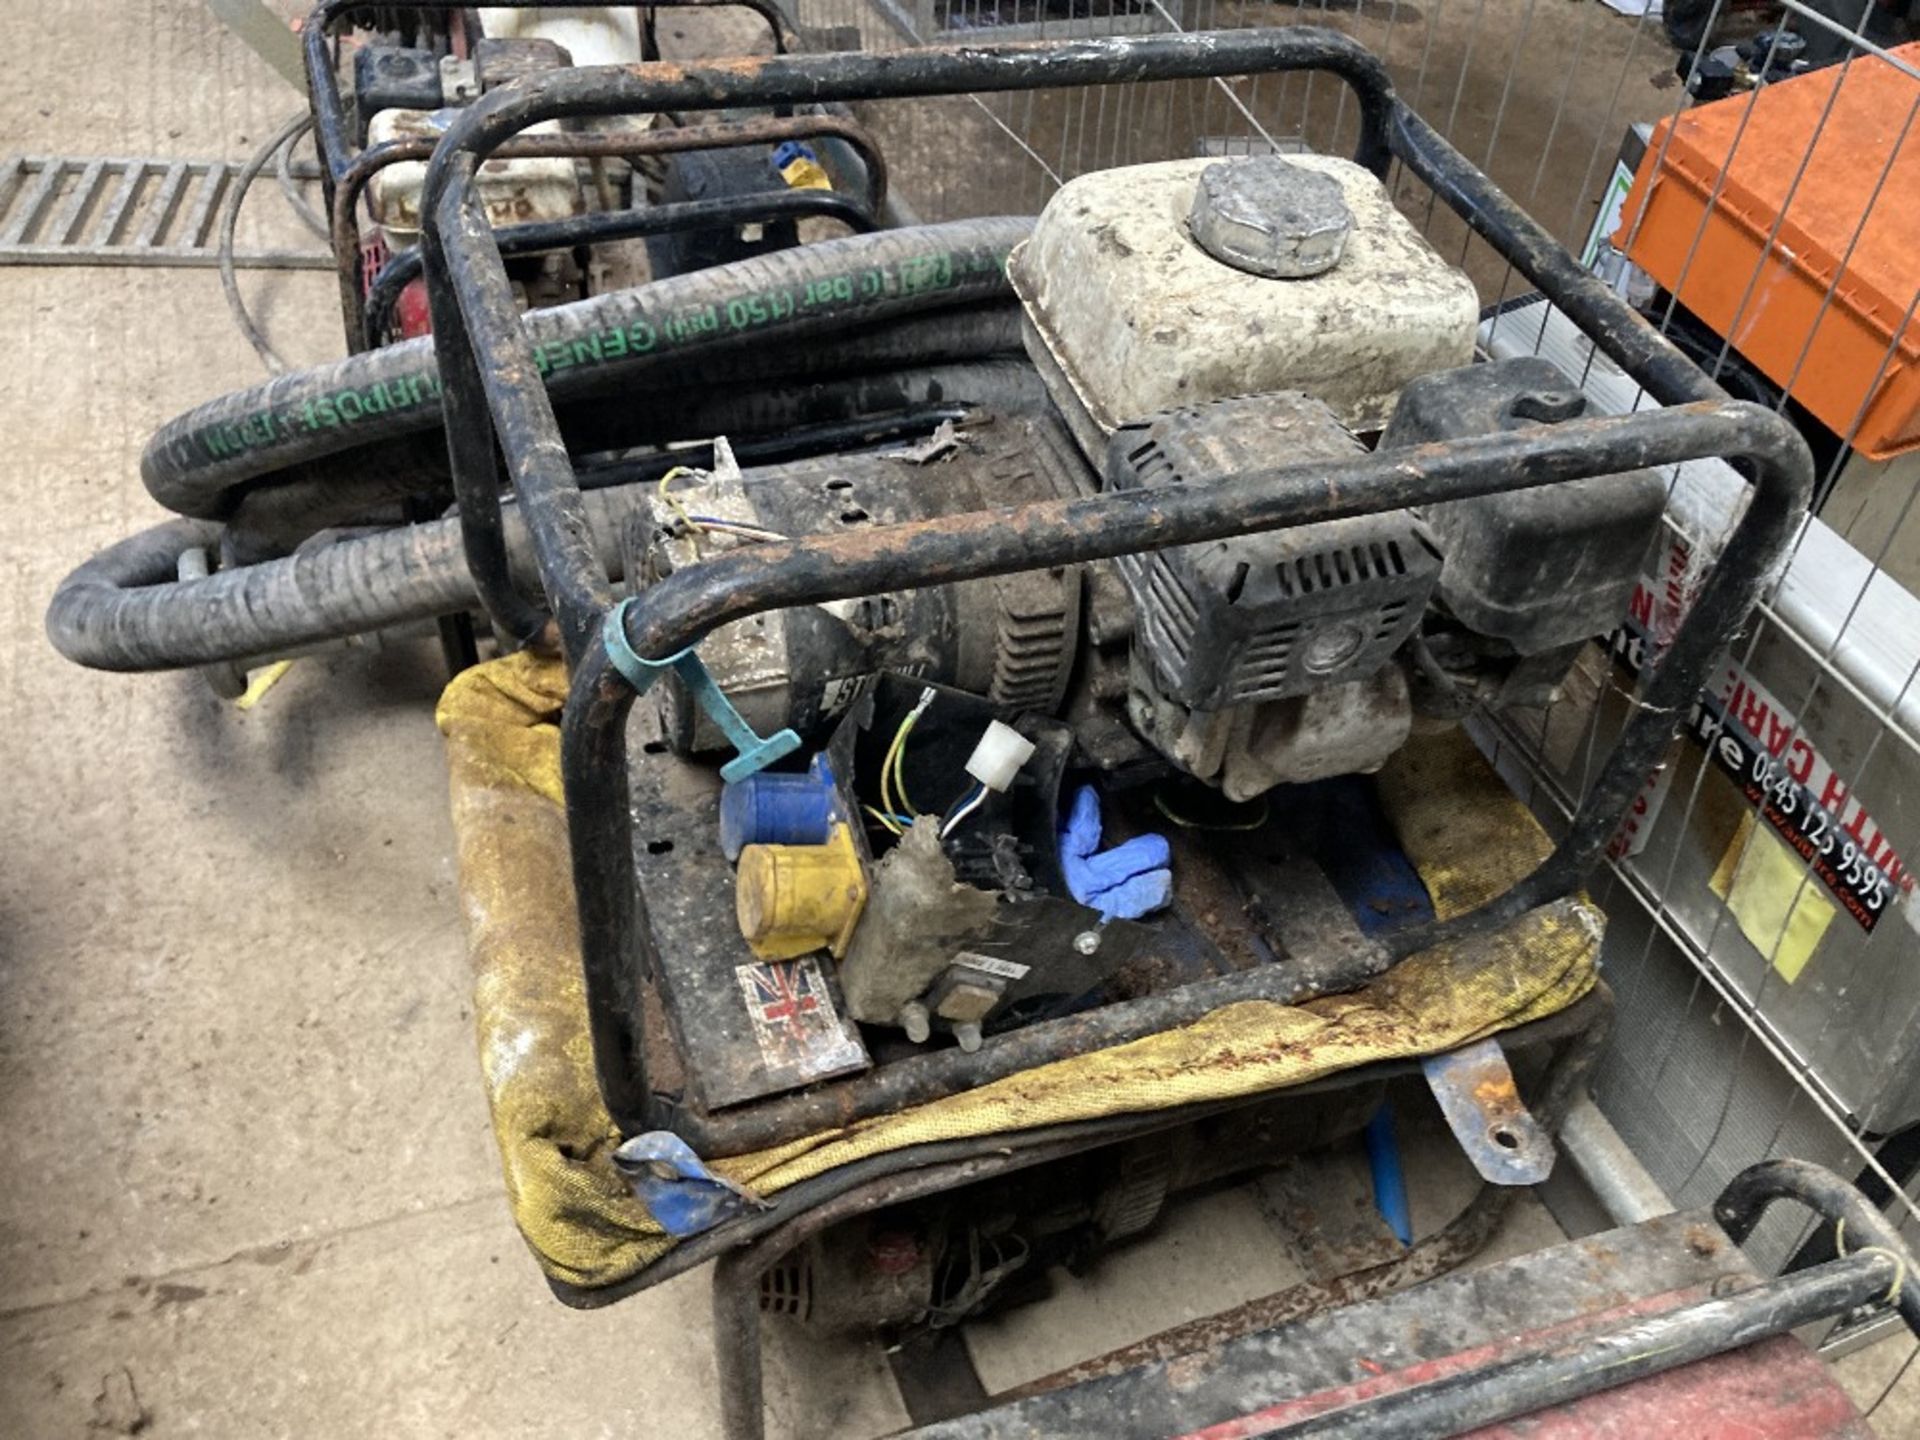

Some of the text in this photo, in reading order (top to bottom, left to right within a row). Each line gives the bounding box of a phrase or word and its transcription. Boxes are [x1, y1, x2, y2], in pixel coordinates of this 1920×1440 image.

[727, 287, 795, 328] (150
[803, 275, 854, 305] bar
[1717, 668, 1815, 785] CARE
[1836, 841, 1890, 910] 9595
